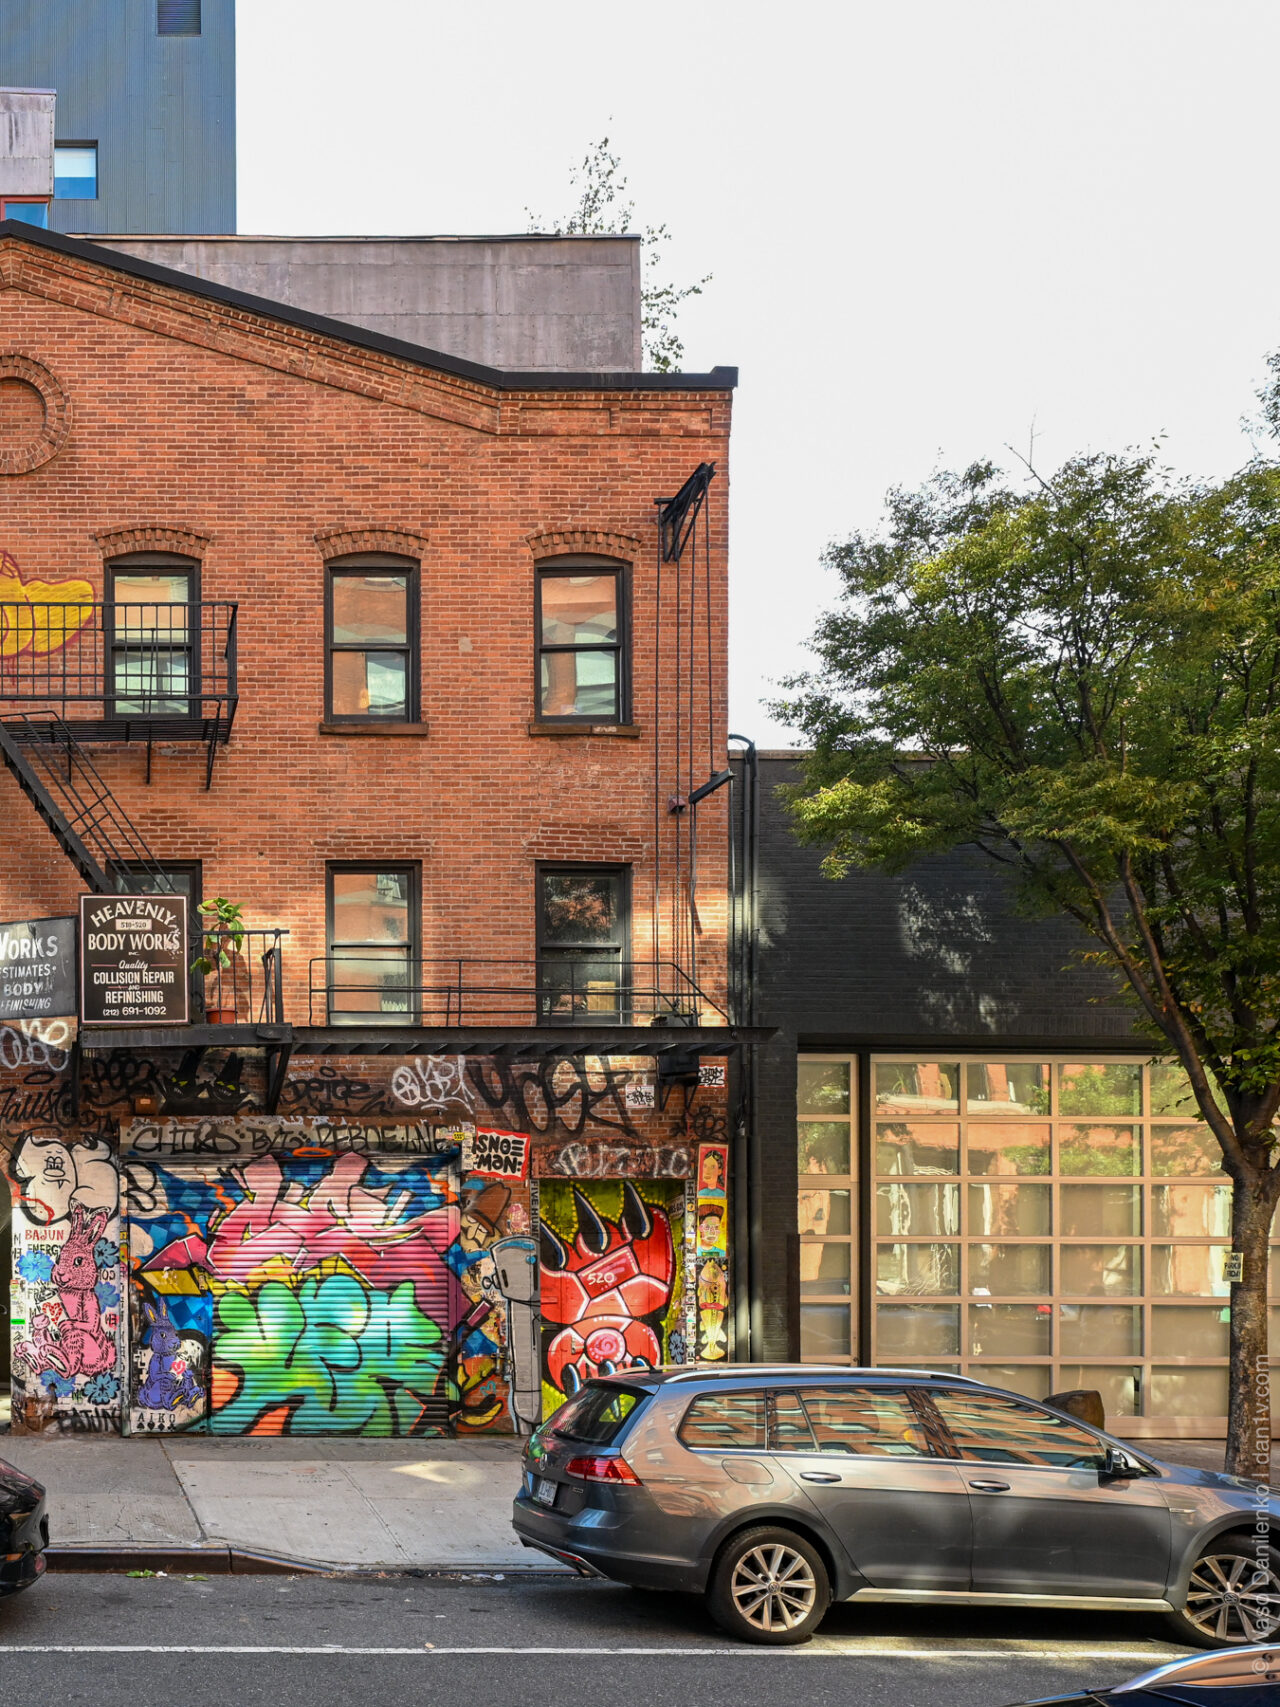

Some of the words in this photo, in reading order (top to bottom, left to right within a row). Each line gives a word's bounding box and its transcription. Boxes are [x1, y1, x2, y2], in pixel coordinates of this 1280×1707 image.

[90, 900, 177, 929] HEAVENLY
[88, 933, 126, 951] BODY
[129, 933, 180, 951] WORKS
[118, 960, 149, 973] Quality
[93, 971, 140, 984] COLLISION
[142, 971, 175, 984] REPAIR
[3, 981, 44, 997] BODY
[105, 990, 164, 1004] REFINISHING
[102, 1008, 120, 1017] (212)
[122, 1006, 167, 1016] 691-1092
[530, 1179, 539, 1207] FIVE
[24, 1229, 65, 1241] BAJUN
[586, 1272, 615, 1286] 520
